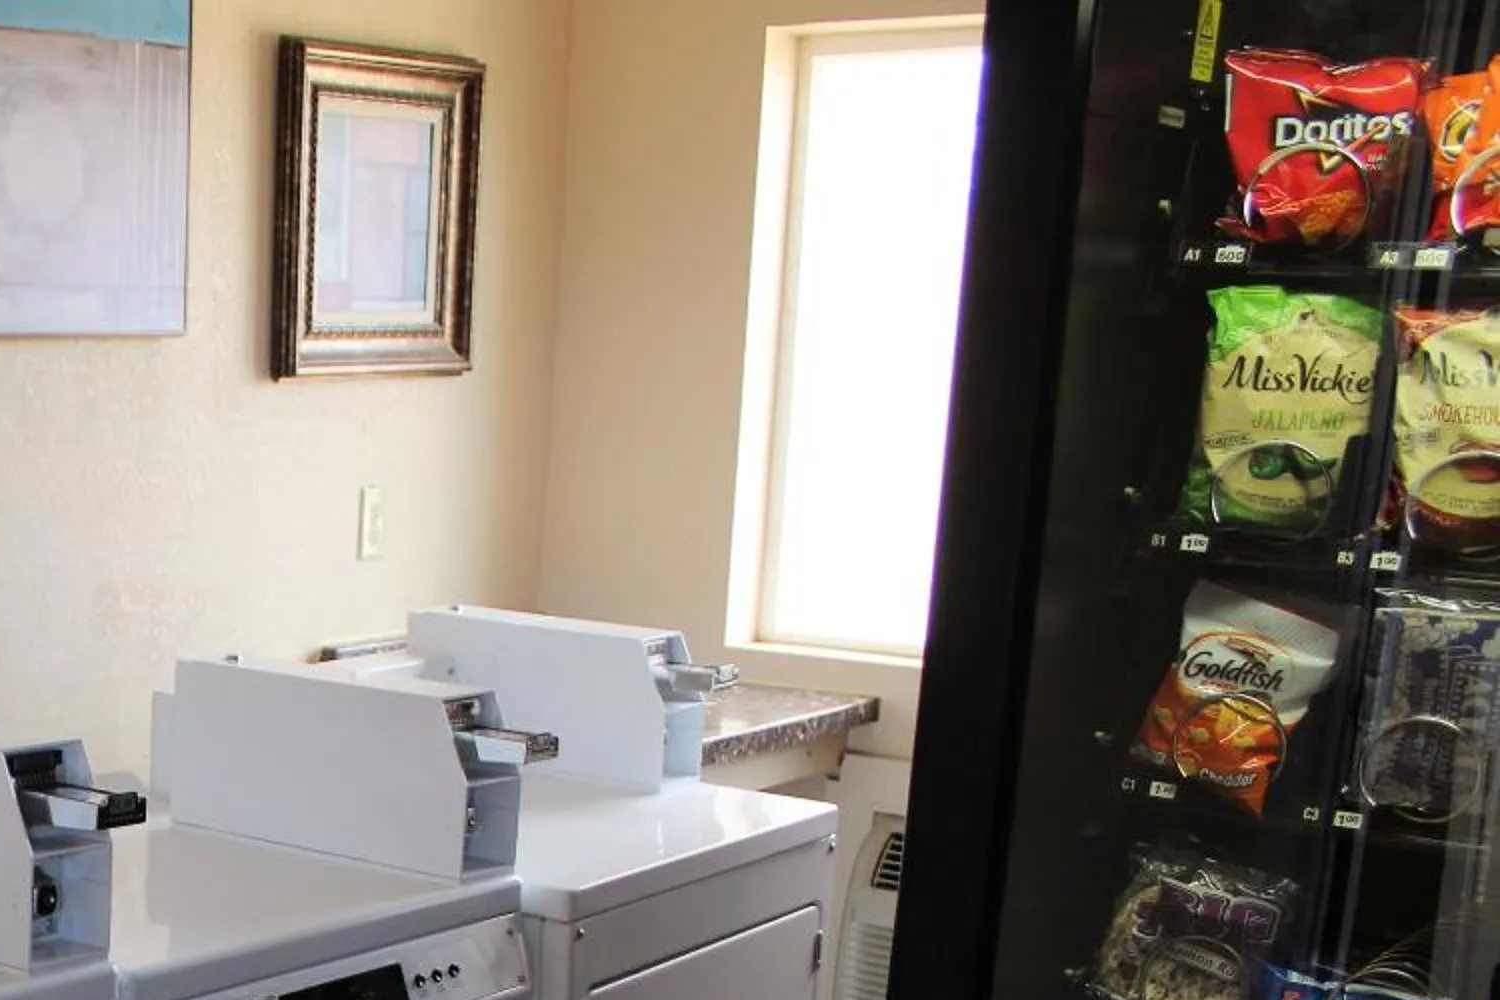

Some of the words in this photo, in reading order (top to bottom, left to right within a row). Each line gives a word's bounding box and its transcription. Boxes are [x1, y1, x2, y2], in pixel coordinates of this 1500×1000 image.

[1274, 111, 1415, 147] Doritos
[1221, 354, 1295, 393] Miss
[1183, 651, 1285, 692] Goldfish
[1199, 767, 1258, 788] Cheddar
